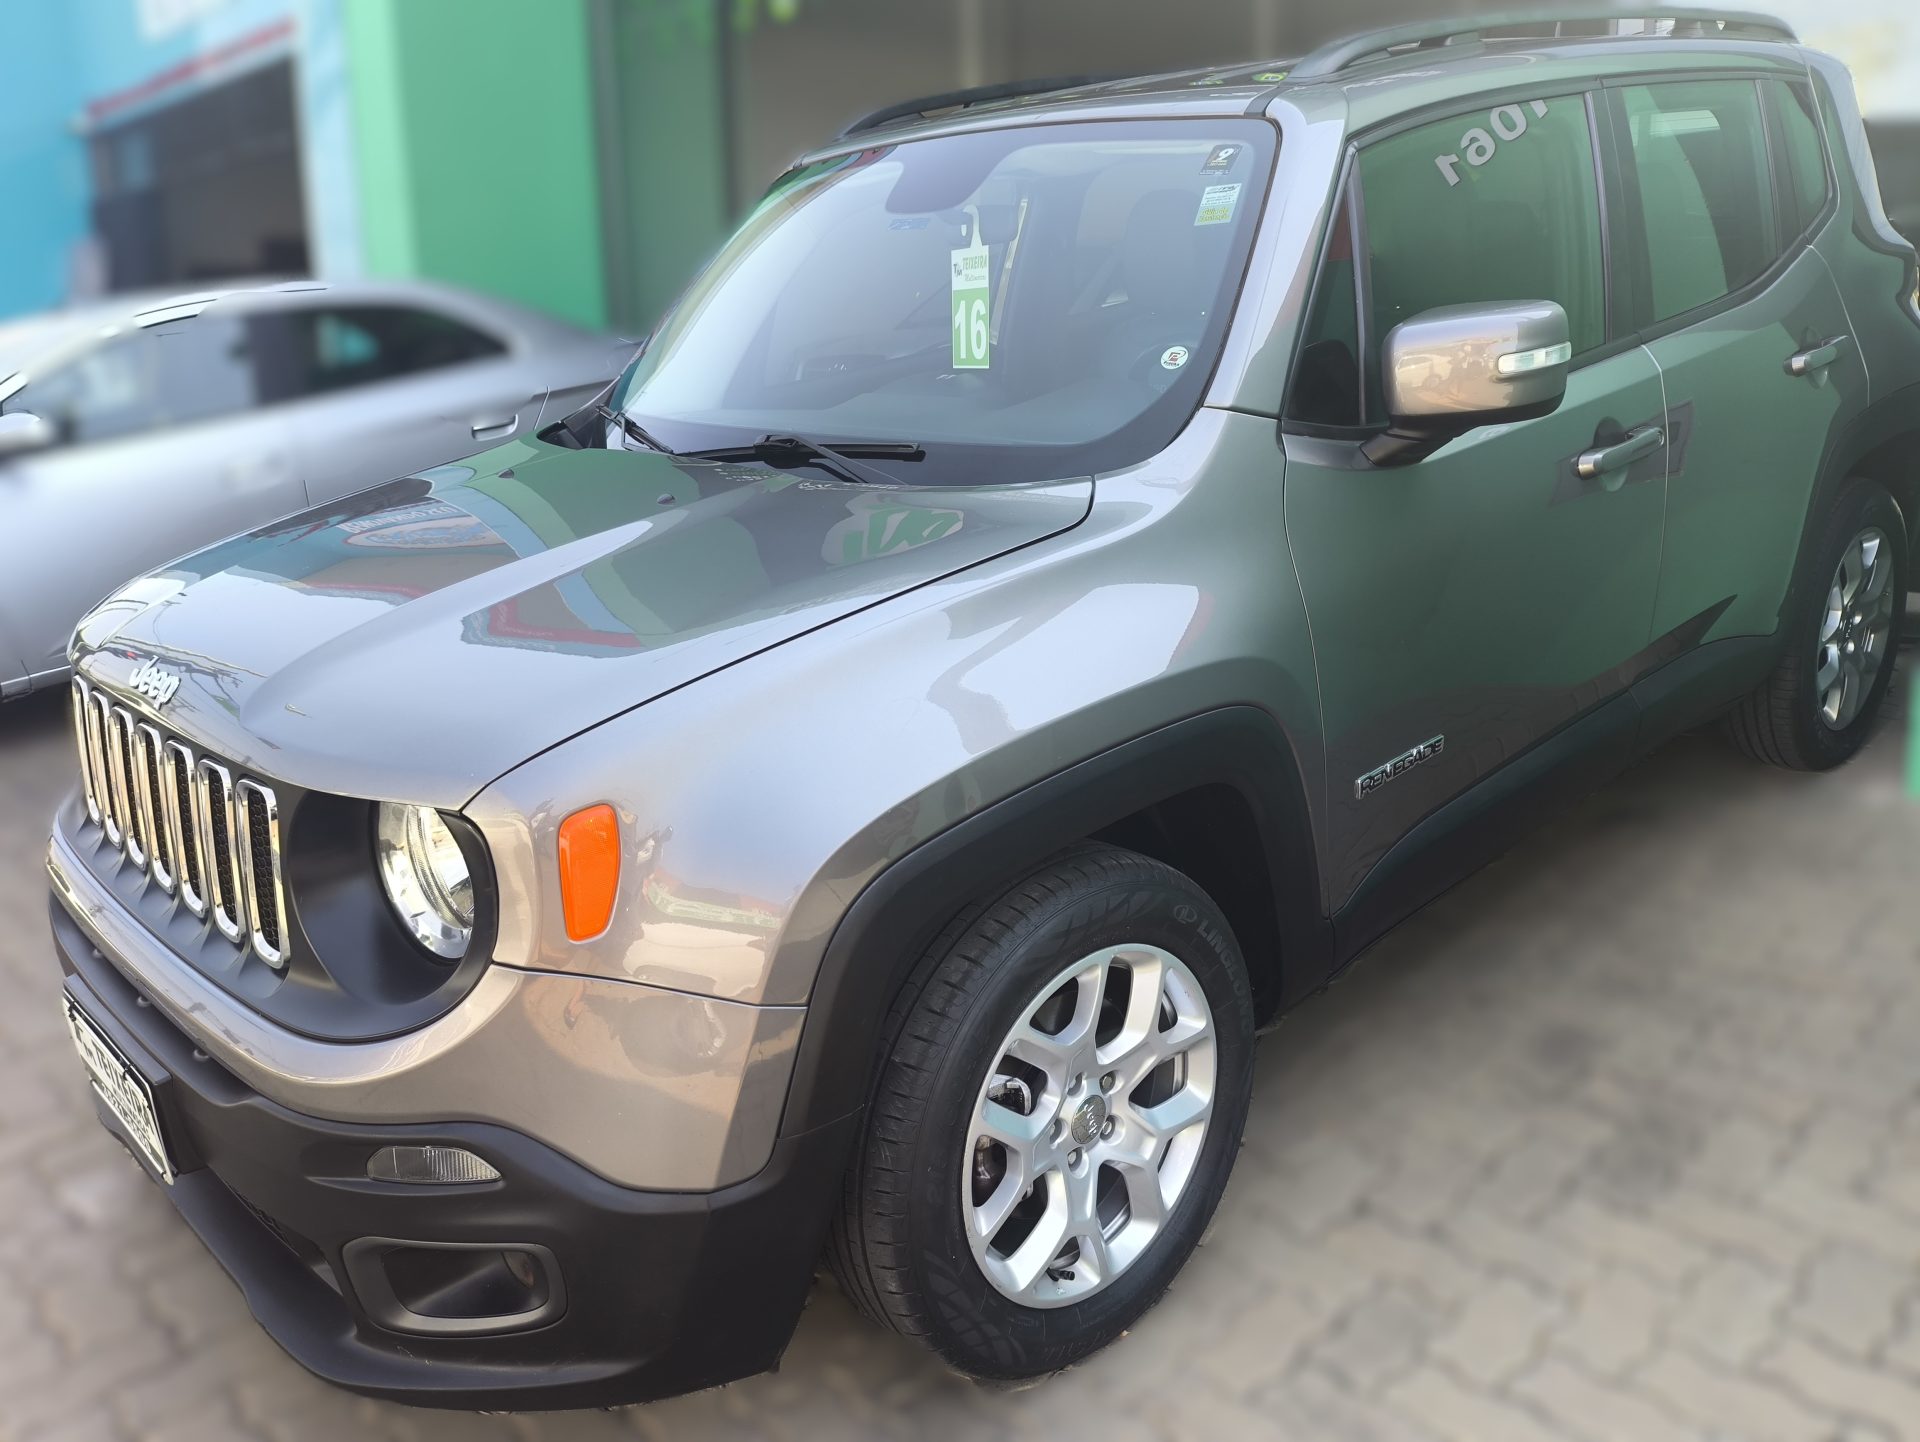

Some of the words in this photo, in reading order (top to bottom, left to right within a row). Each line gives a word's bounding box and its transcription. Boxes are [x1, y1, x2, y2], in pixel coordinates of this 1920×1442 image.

[962, 255, 988, 271] TEIXEIRA
[954, 299, 987, 360] 16
[129, 655, 181, 710] Jeep
[1354, 734, 1444, 799] RENEGADE
[91, 1040, 155, 1136] TEIXEIRA
[1083, 1103, 1098, 1135] Jeep
